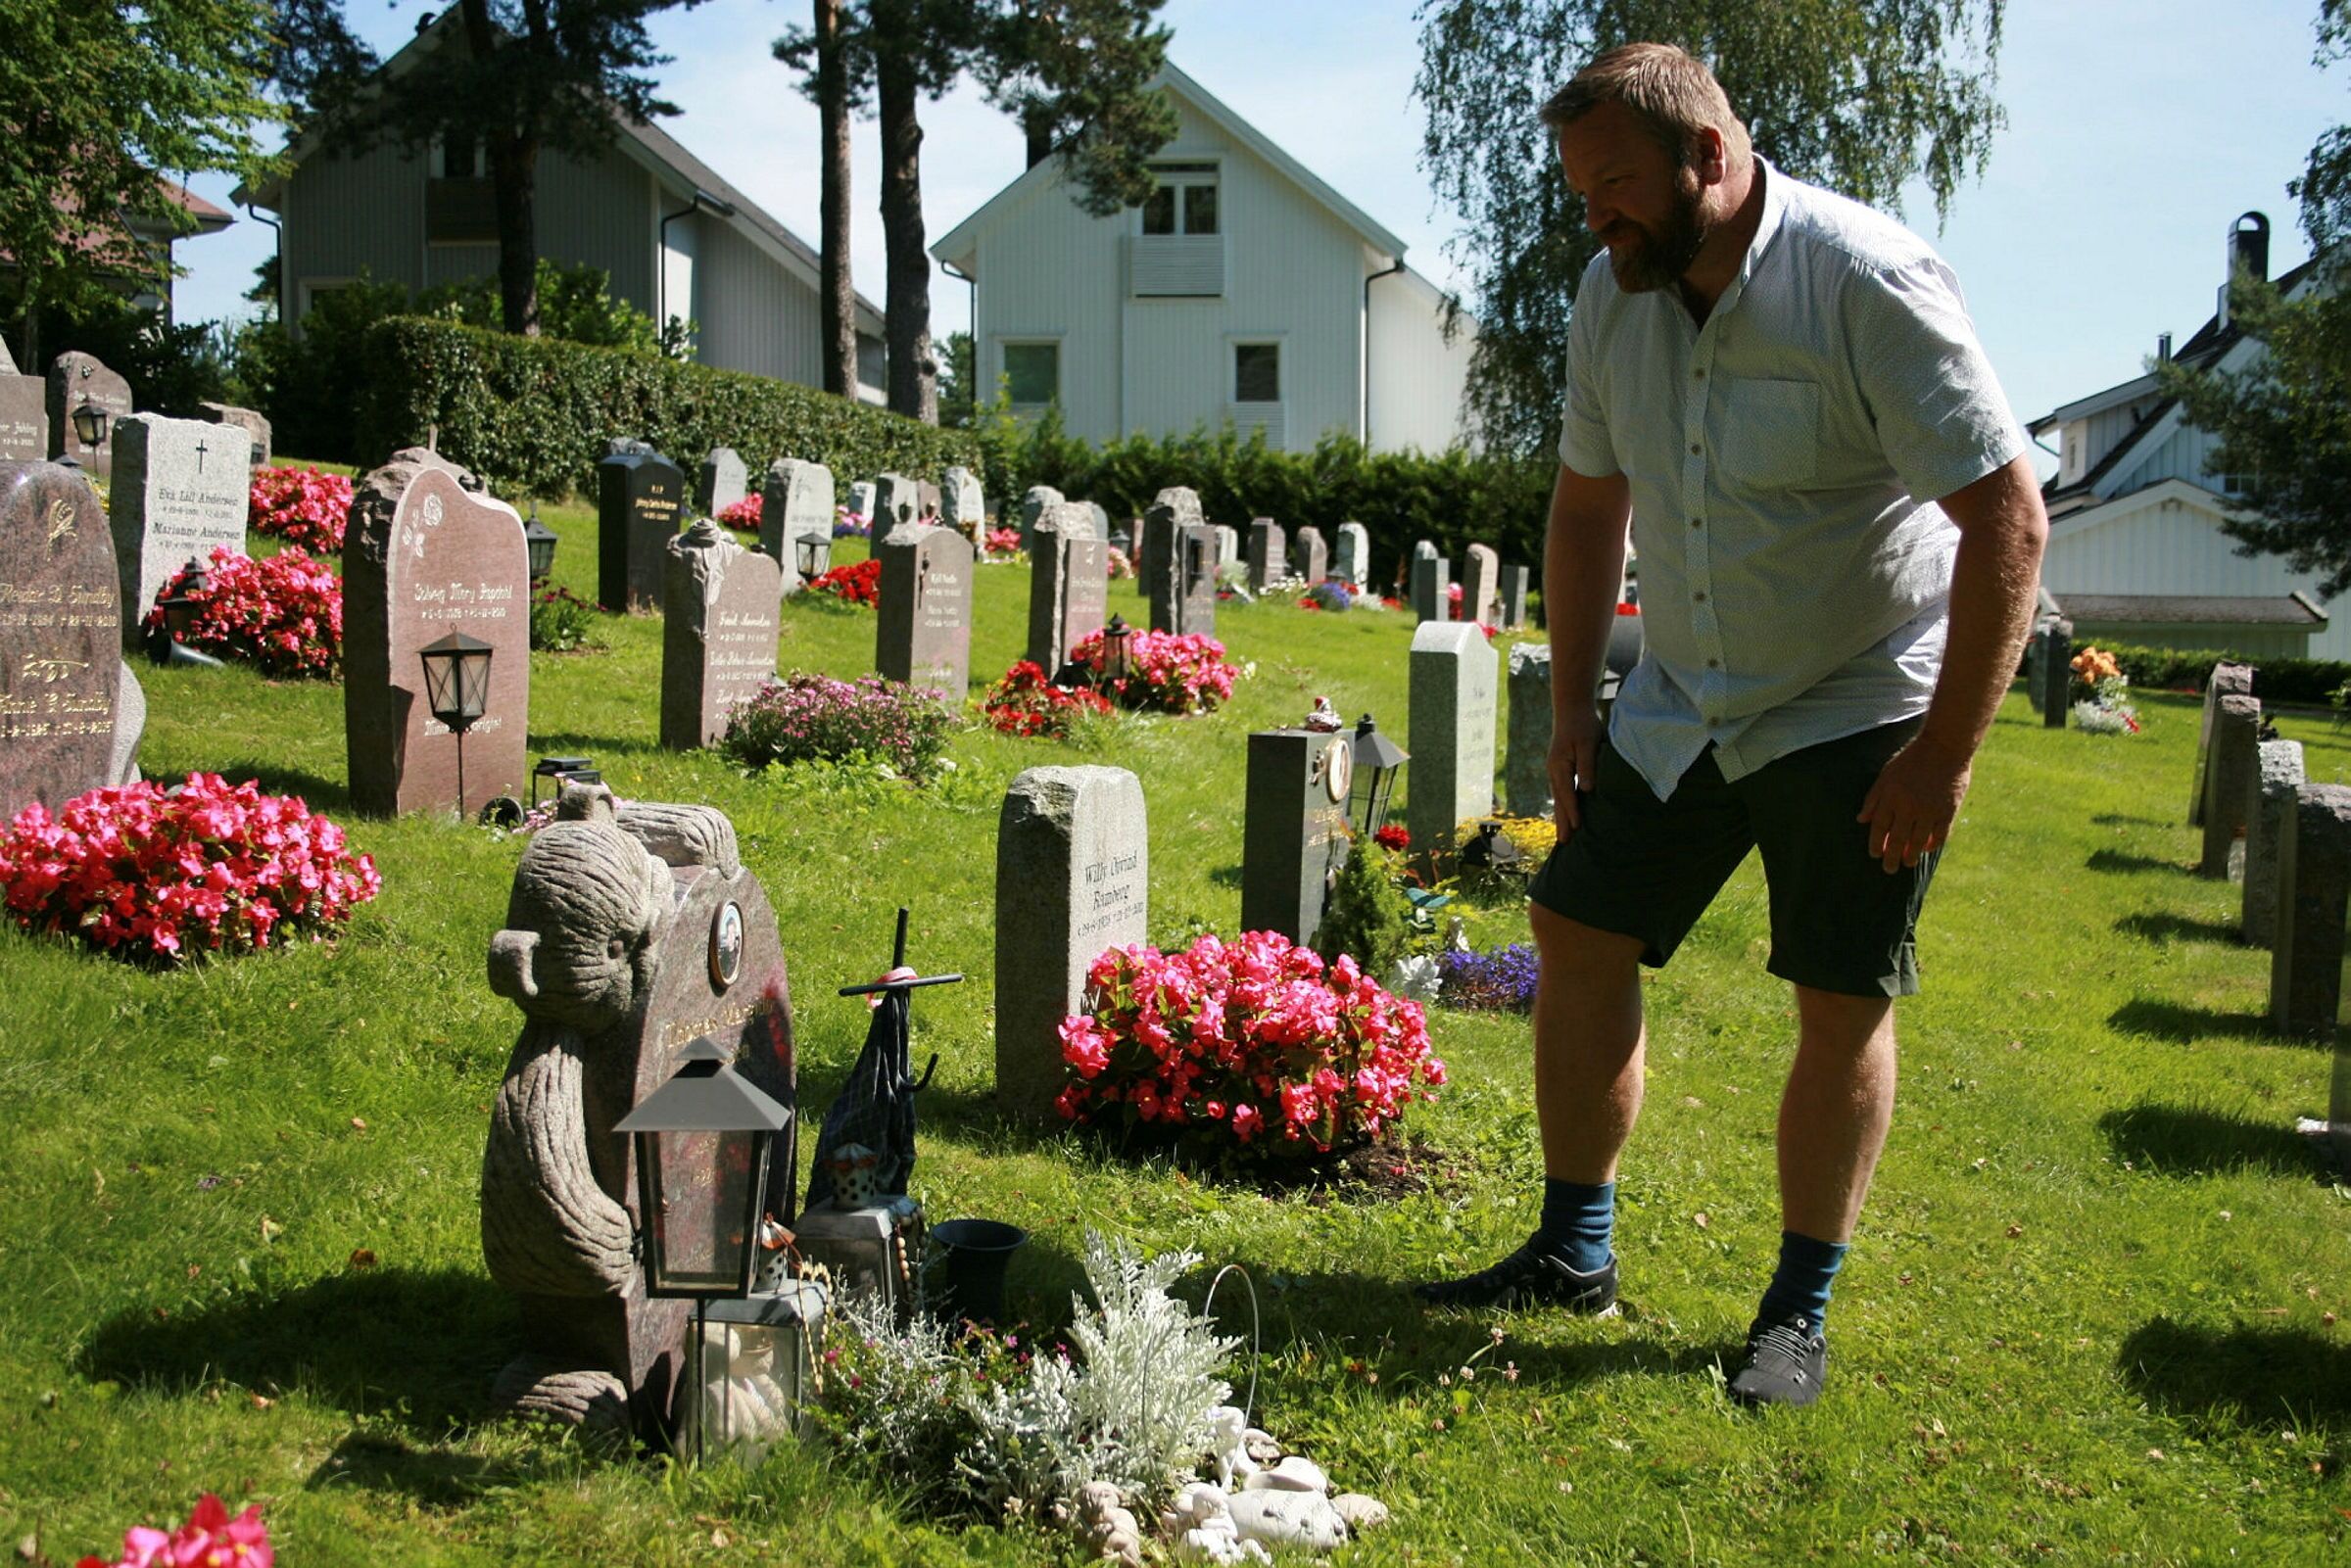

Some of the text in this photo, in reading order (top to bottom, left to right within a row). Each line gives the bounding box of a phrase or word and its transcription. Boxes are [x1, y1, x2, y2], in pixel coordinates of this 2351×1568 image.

[198, 493, 239, 507] Andersen
[153, 522, 241, 541] Marianne Andersen
